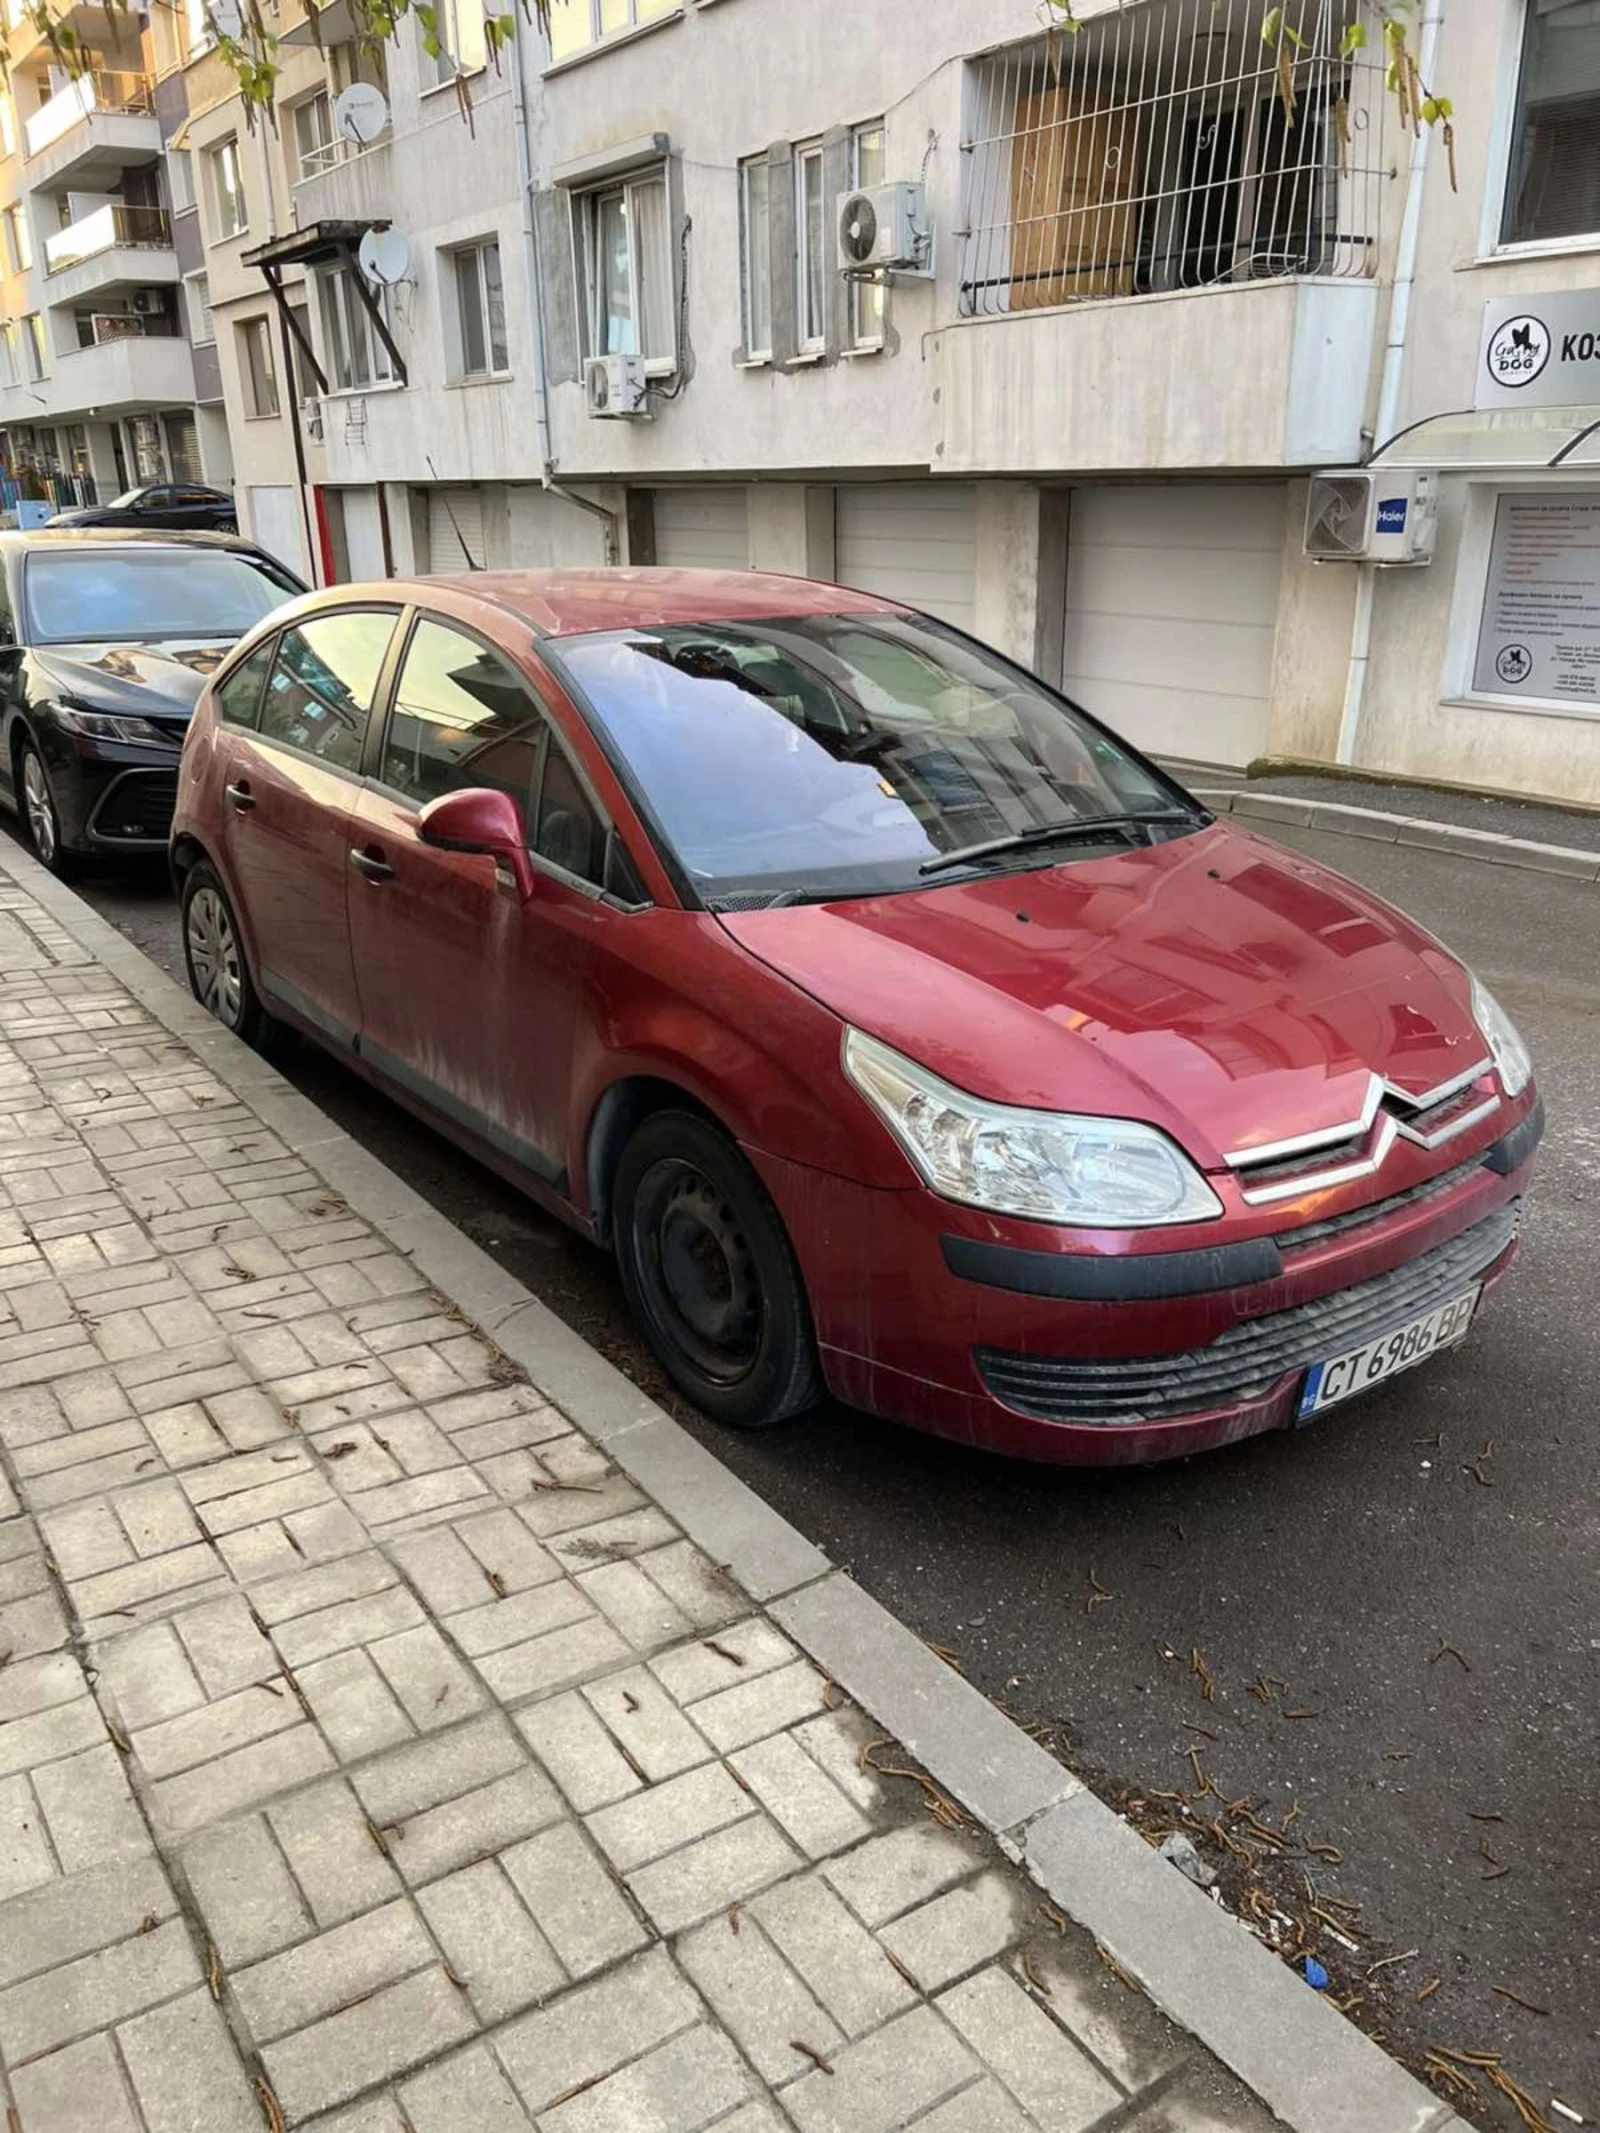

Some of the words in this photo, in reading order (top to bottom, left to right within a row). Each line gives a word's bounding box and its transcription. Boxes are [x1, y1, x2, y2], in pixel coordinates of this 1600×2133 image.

[1499, 358, 1533, 371] DOG
[1377, 511, 1405, 522] Haier
[1321, 1349, 1368, 1401] CT
[1367, 1316, 1434, 1379] 6986
[1434, 1294, 1473, 1344] BP
